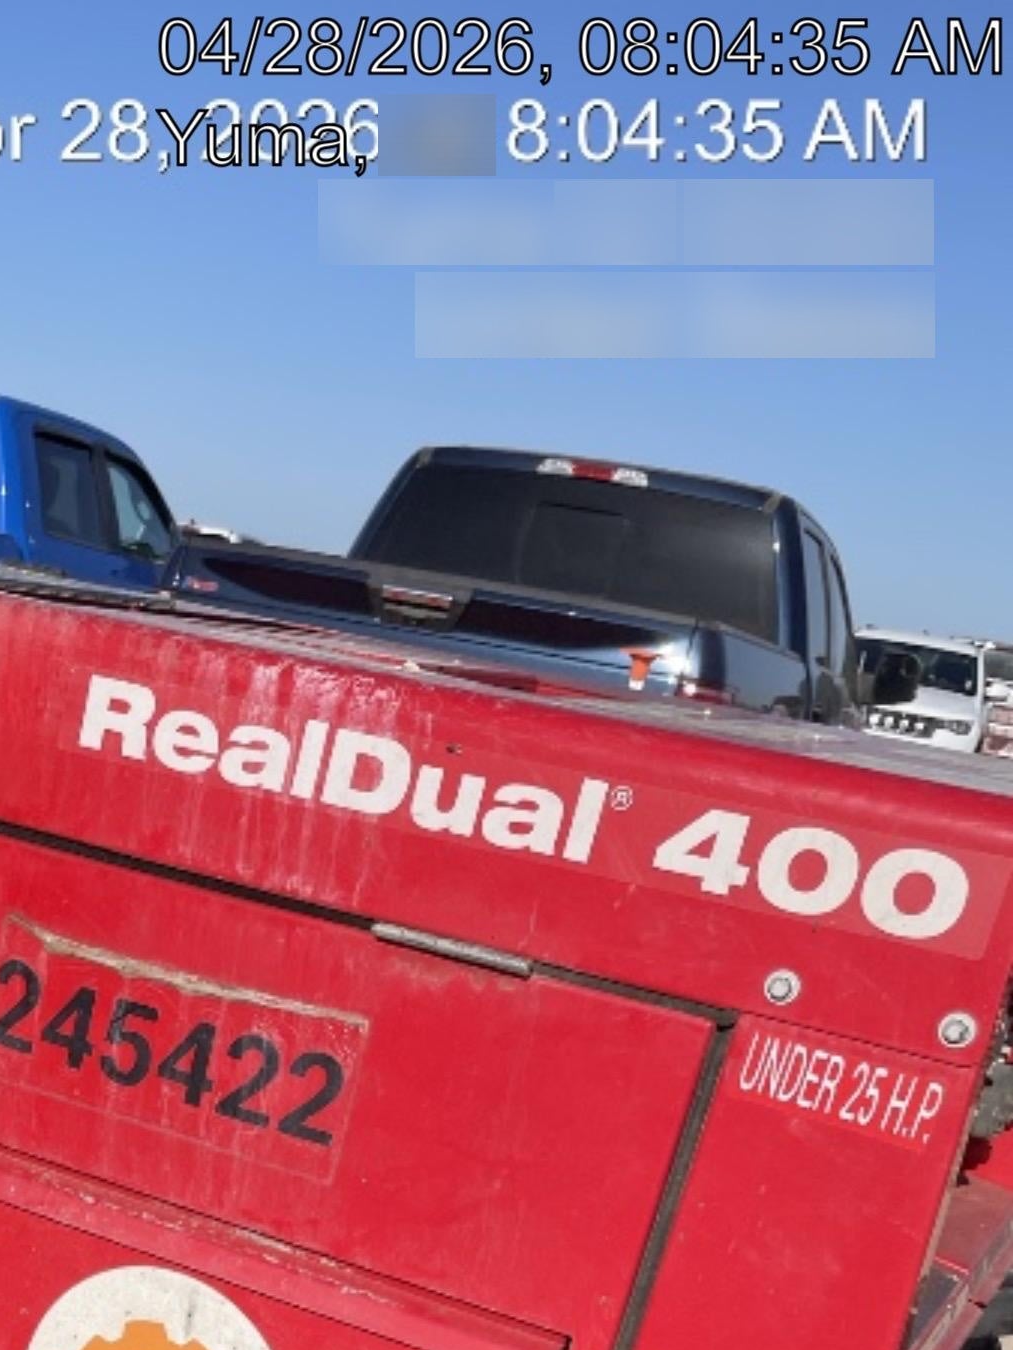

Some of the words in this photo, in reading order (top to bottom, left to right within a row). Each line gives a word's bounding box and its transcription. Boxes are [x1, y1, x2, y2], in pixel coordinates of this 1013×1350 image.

[652, 809, 970, 940] 400
[739, 1032, 846, 1114] UNDER
[839, 1061, 888, 1126] 25
[880, 1073, 943, 1144] H.P.
